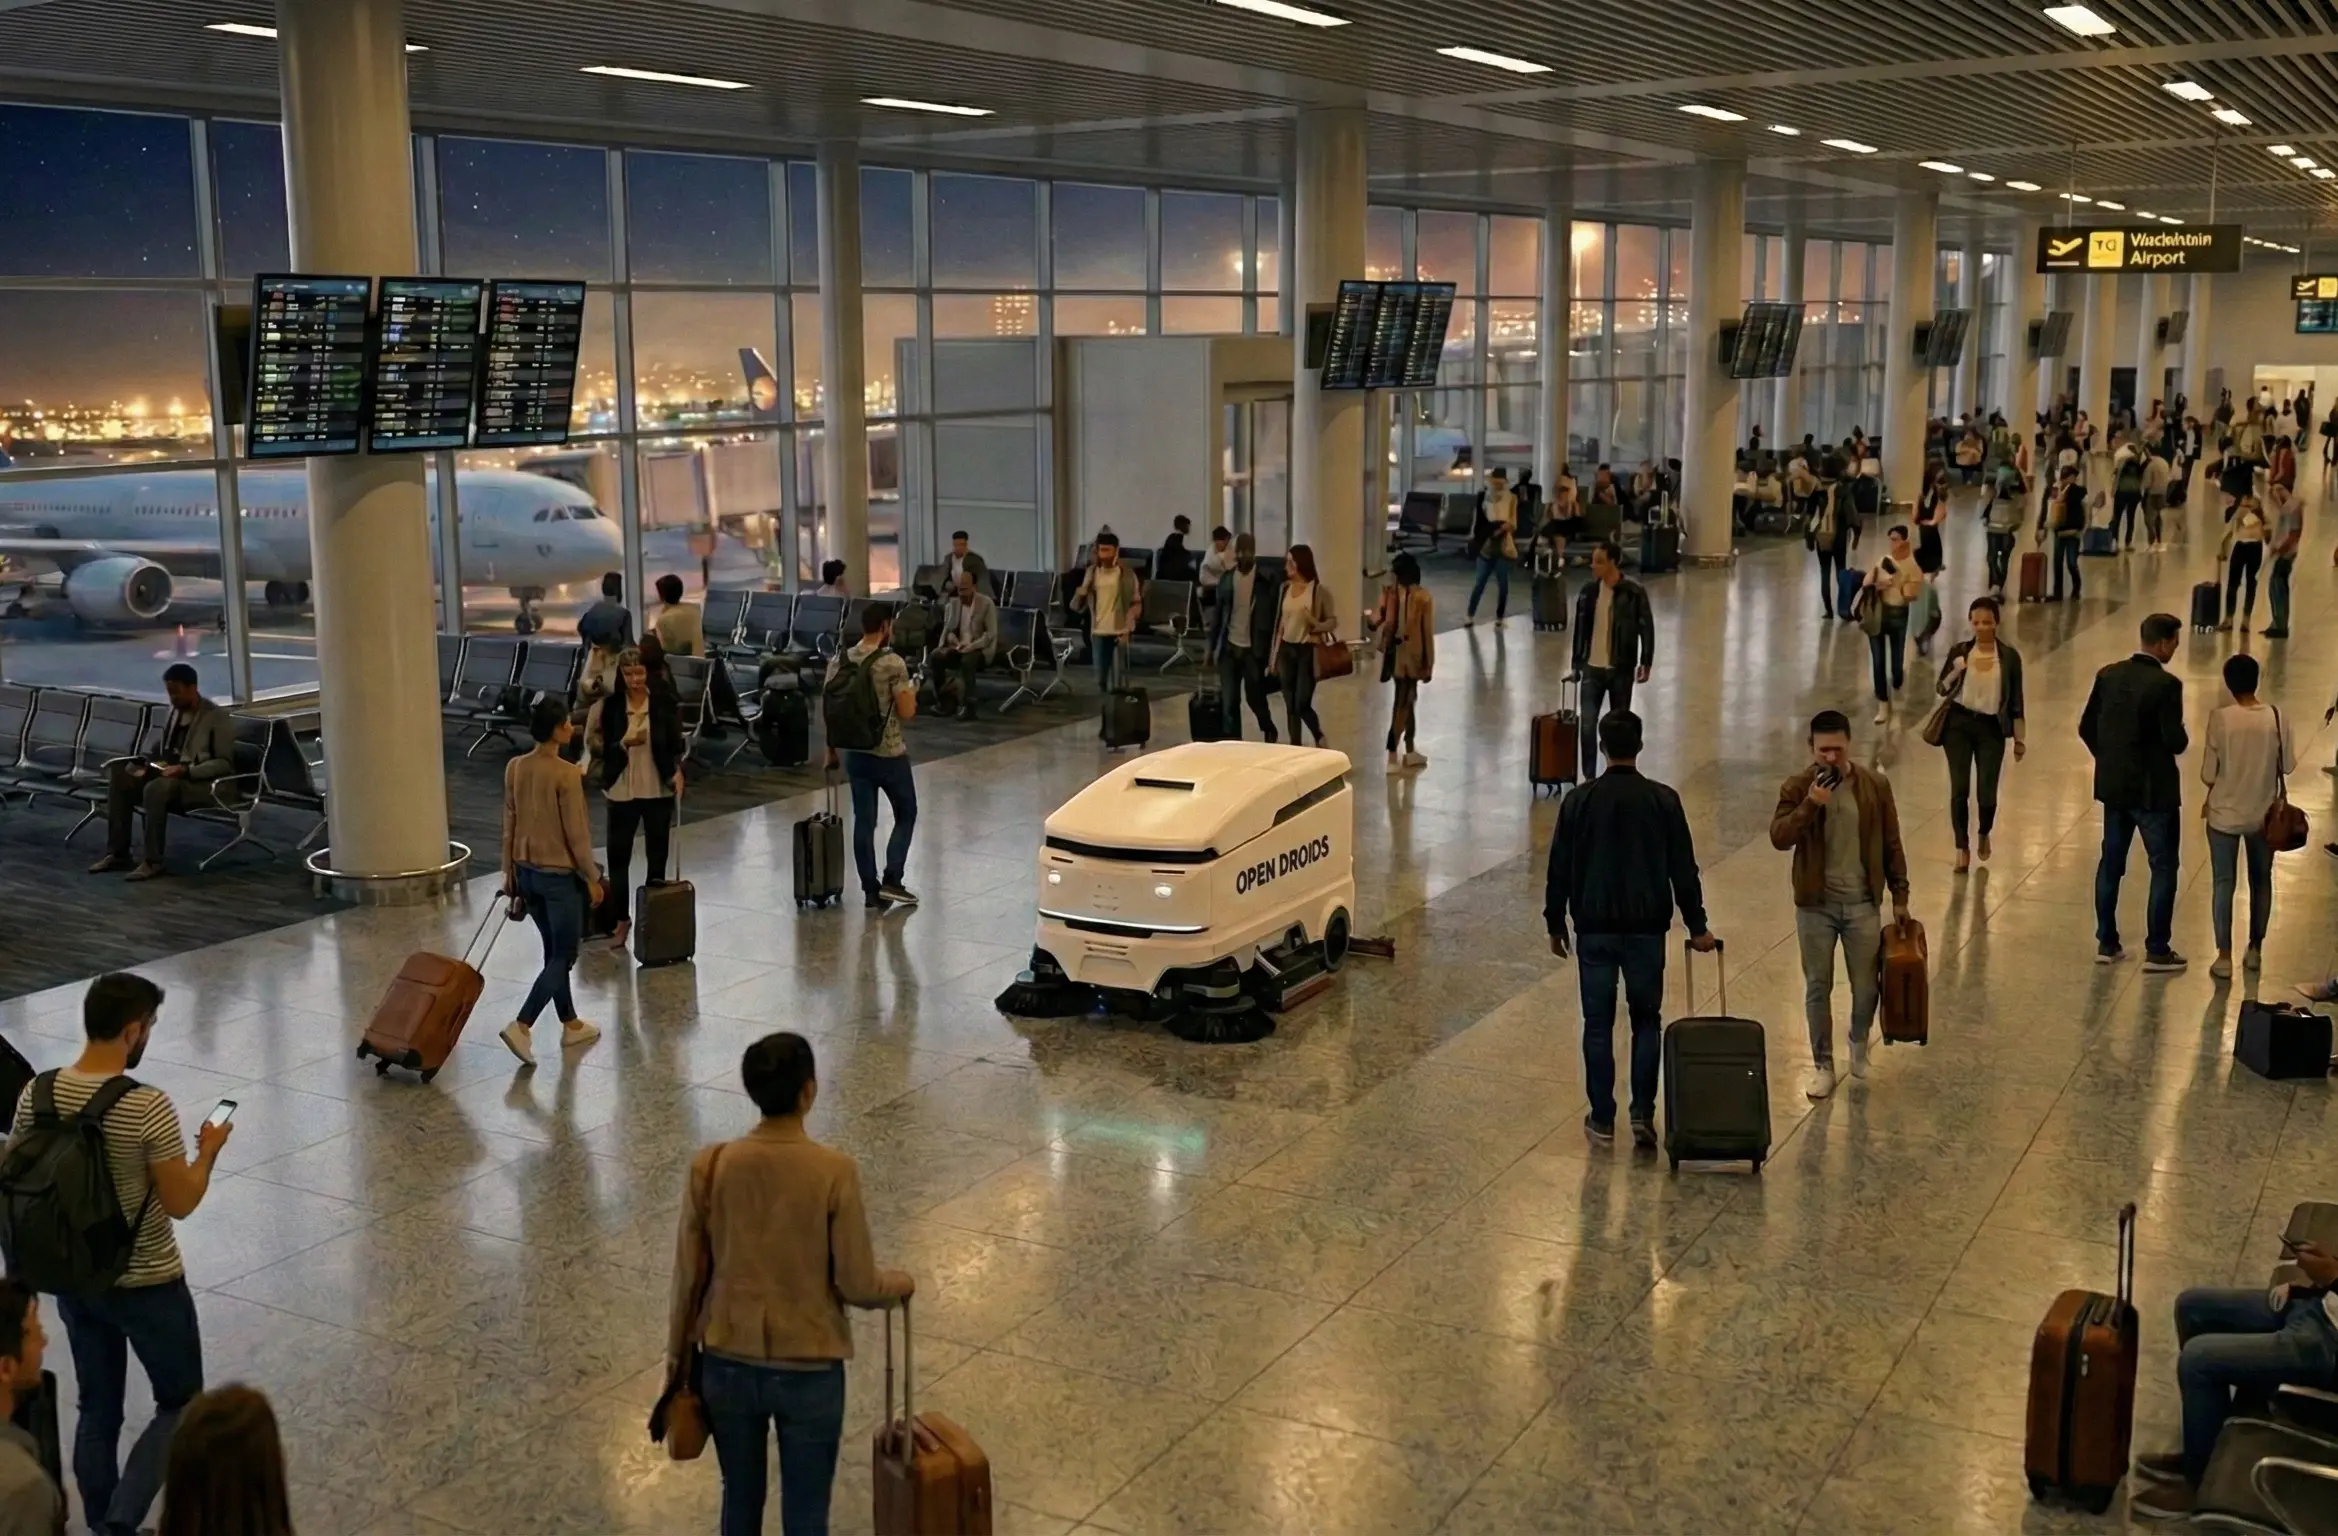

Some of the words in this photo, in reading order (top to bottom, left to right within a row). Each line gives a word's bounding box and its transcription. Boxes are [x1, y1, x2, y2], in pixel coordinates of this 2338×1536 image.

[2130, 250, 2186, 269] Airport
[1236, 857, 1276, 895] OPEN
[1279, 834, 1330, 877] DROIDS
